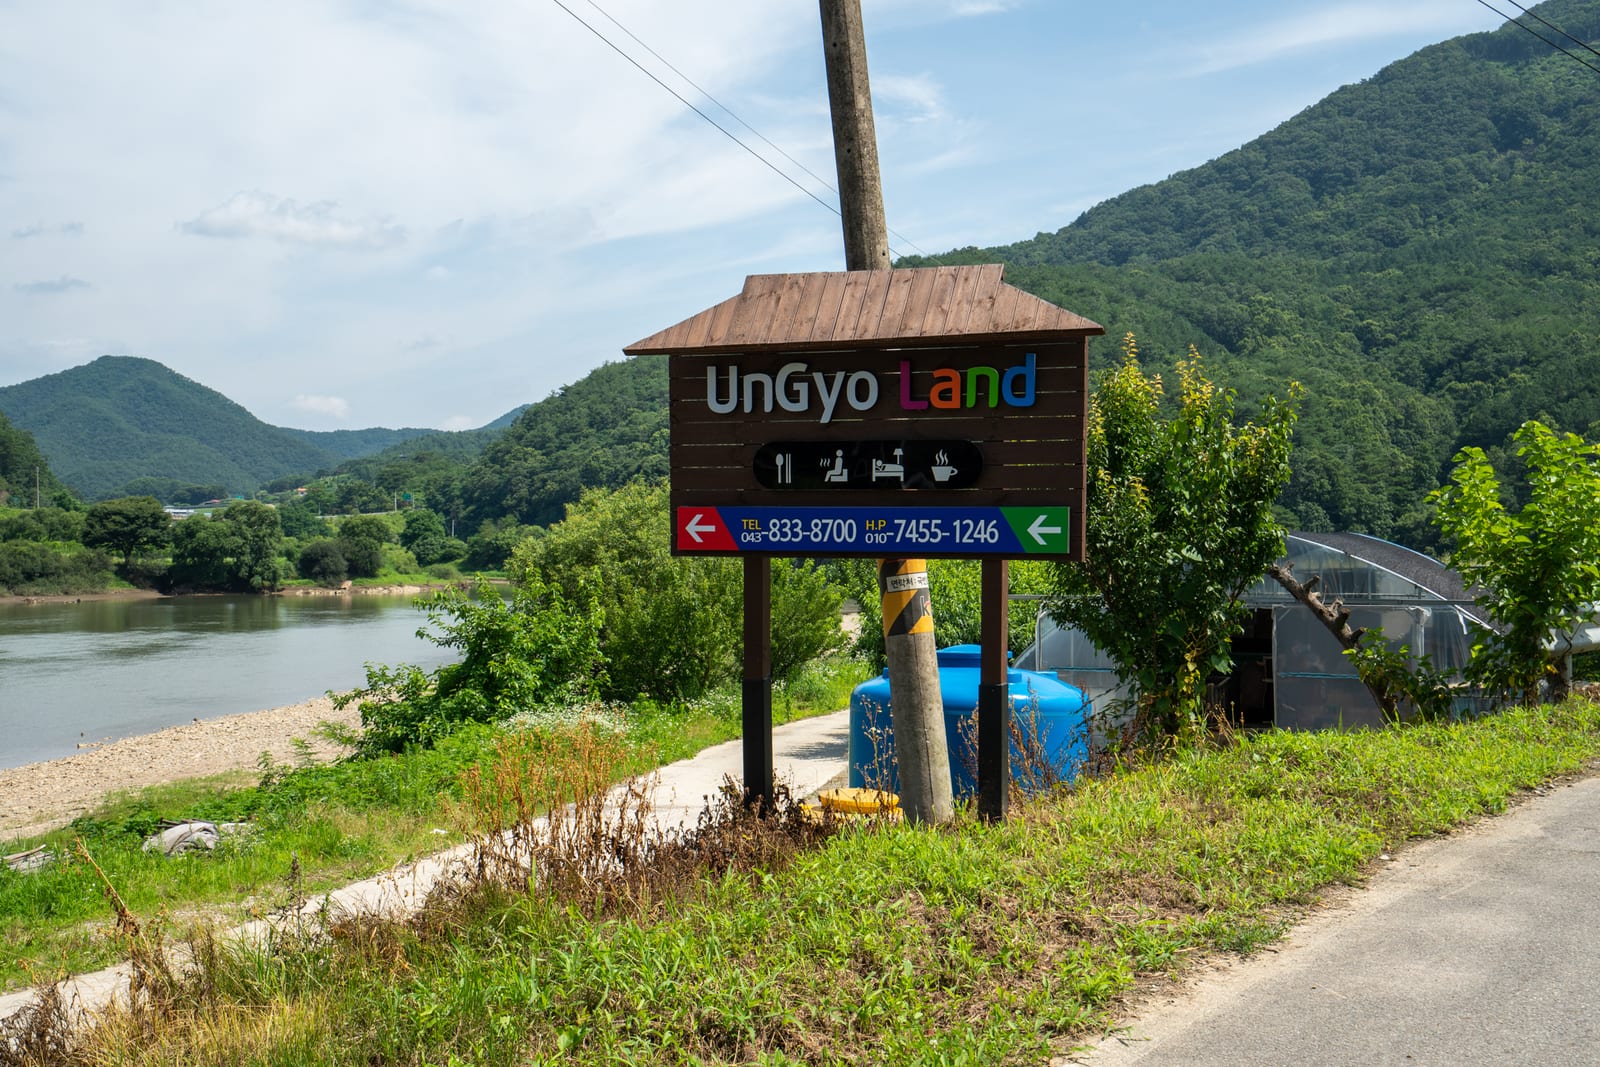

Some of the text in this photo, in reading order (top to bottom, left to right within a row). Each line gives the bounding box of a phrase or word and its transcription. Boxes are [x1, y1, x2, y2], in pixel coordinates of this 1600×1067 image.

[706, 352, 1037, 424] UnGyo Land
[741, 519, 762, 530] TEL
[741, 518, 857, 543] 043-833-8700
[865, 519, 887, 531] H.P
